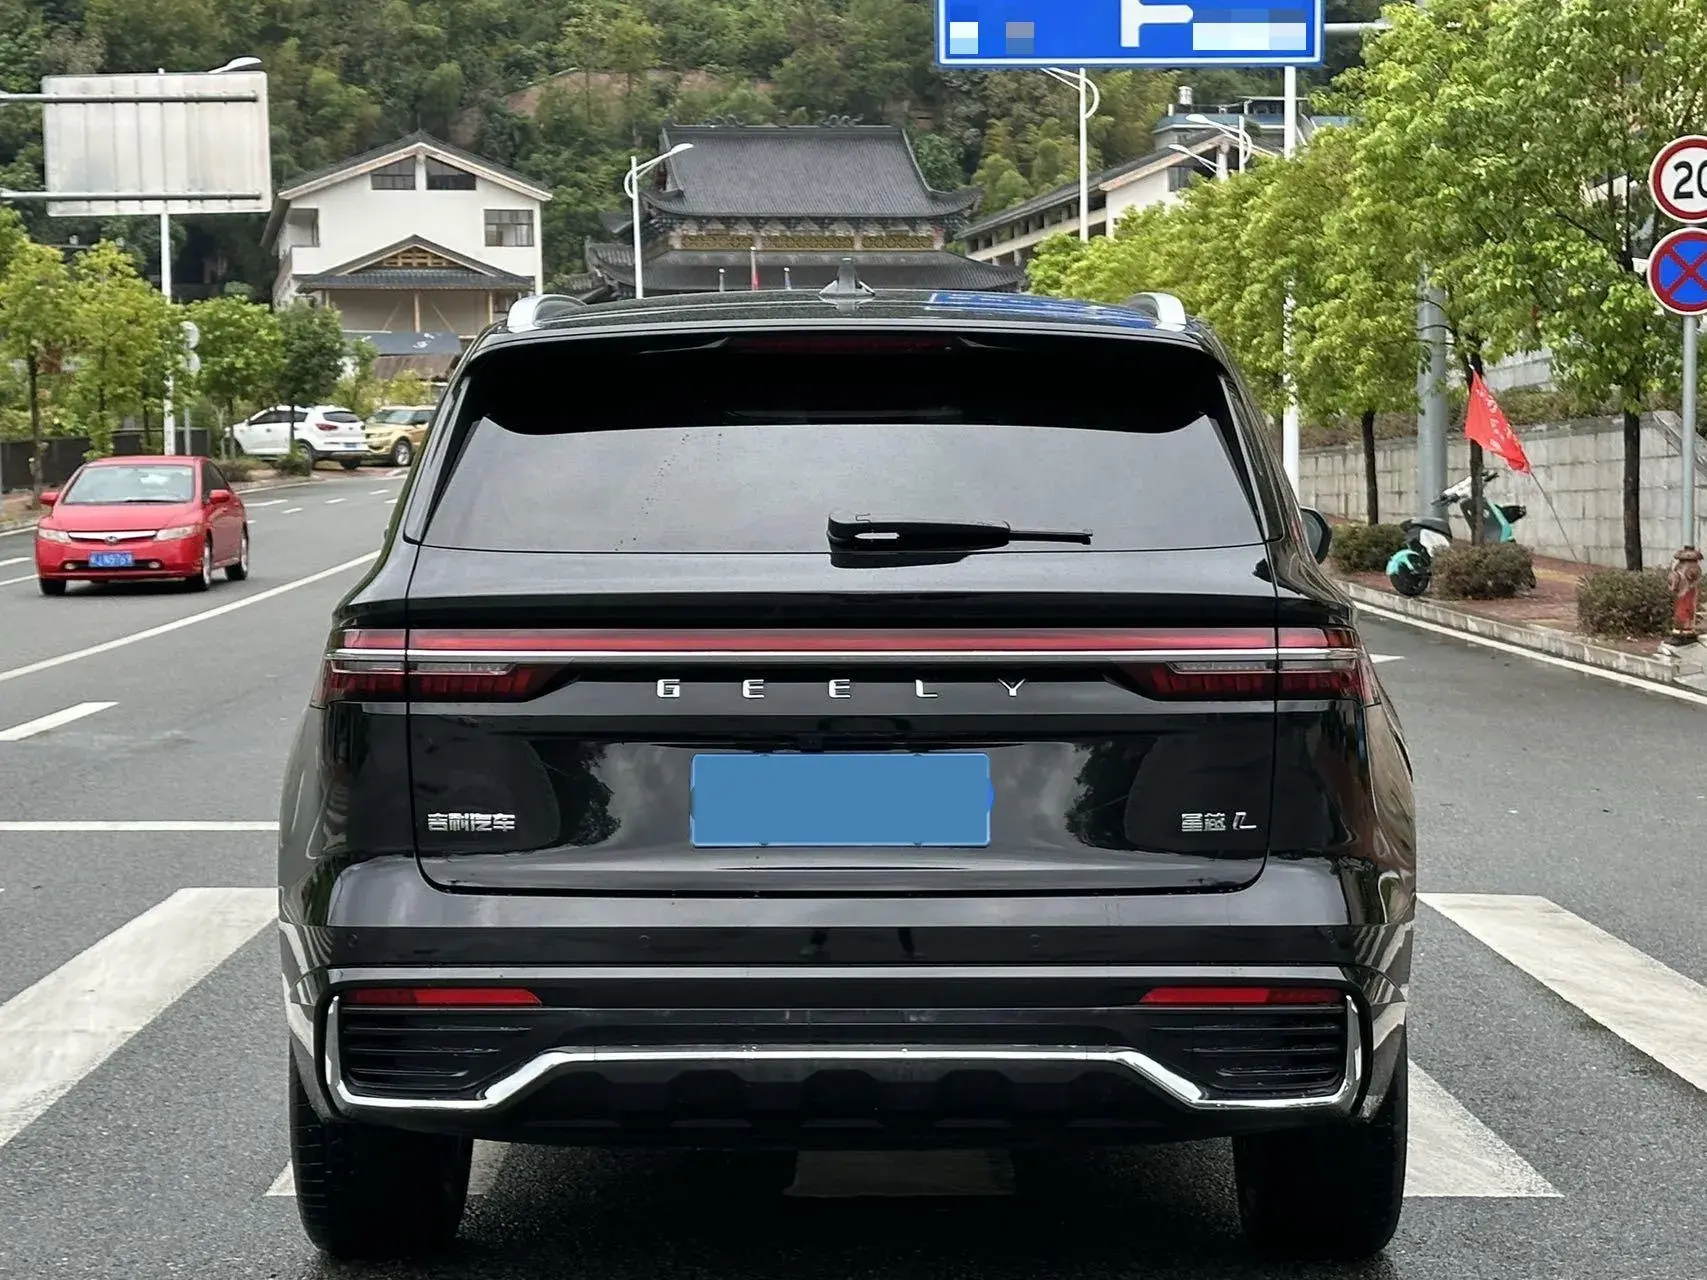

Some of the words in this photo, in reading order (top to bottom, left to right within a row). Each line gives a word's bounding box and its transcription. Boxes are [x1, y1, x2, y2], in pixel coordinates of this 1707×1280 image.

[656, 678, 1026, 699] GEELY
[427, 812, 516, 832] 吉利汽车
